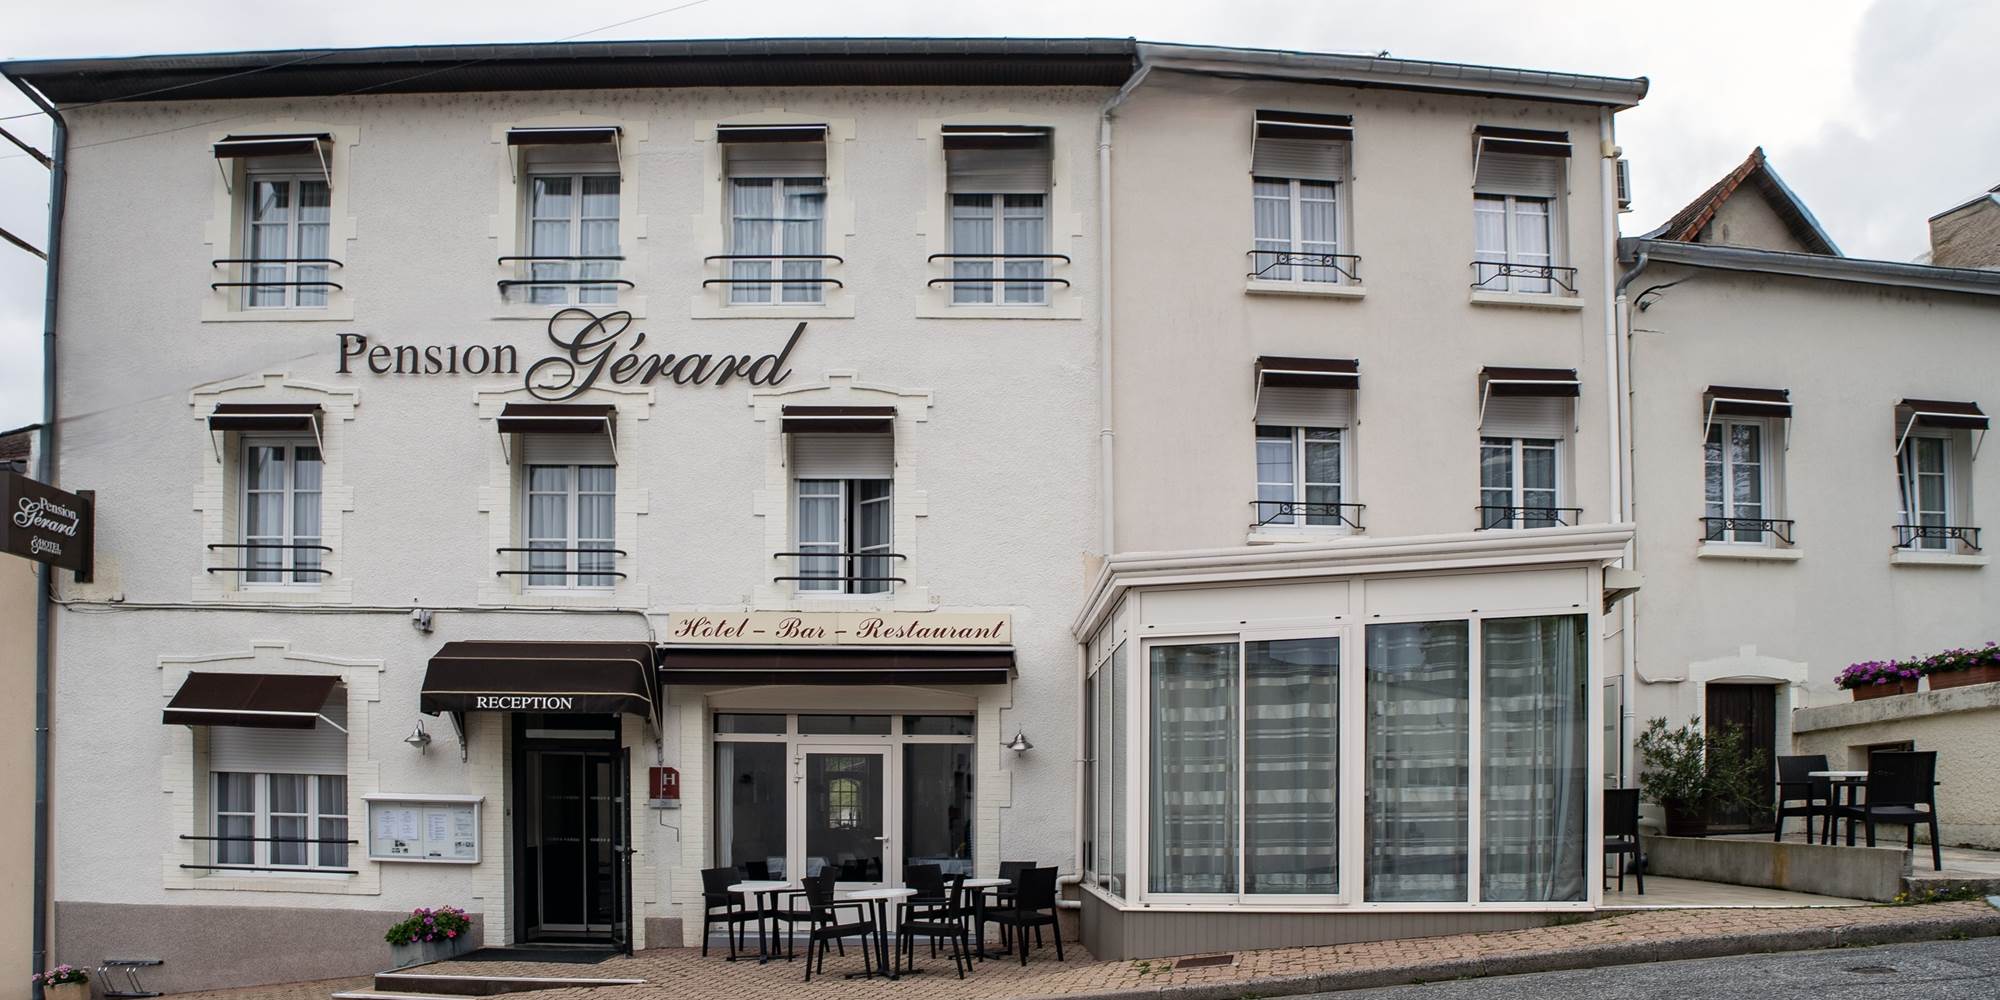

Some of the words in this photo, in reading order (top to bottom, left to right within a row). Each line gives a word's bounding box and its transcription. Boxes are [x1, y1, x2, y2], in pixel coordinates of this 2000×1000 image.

[336, 333, 520, 375] Pension
[525, 307, 808, 401] Gérard
[13, 497, 79, 537] Gérard
[40, 497, 77, 520] Pension
[674, 617, 750, 639] Hôtel
[775, 617, 826, 639] Bar
[856, 617, 1005, 639] Restaurant
[476, 696, 574, 710] RECEPTION
[663, 773, 676, 785] H
